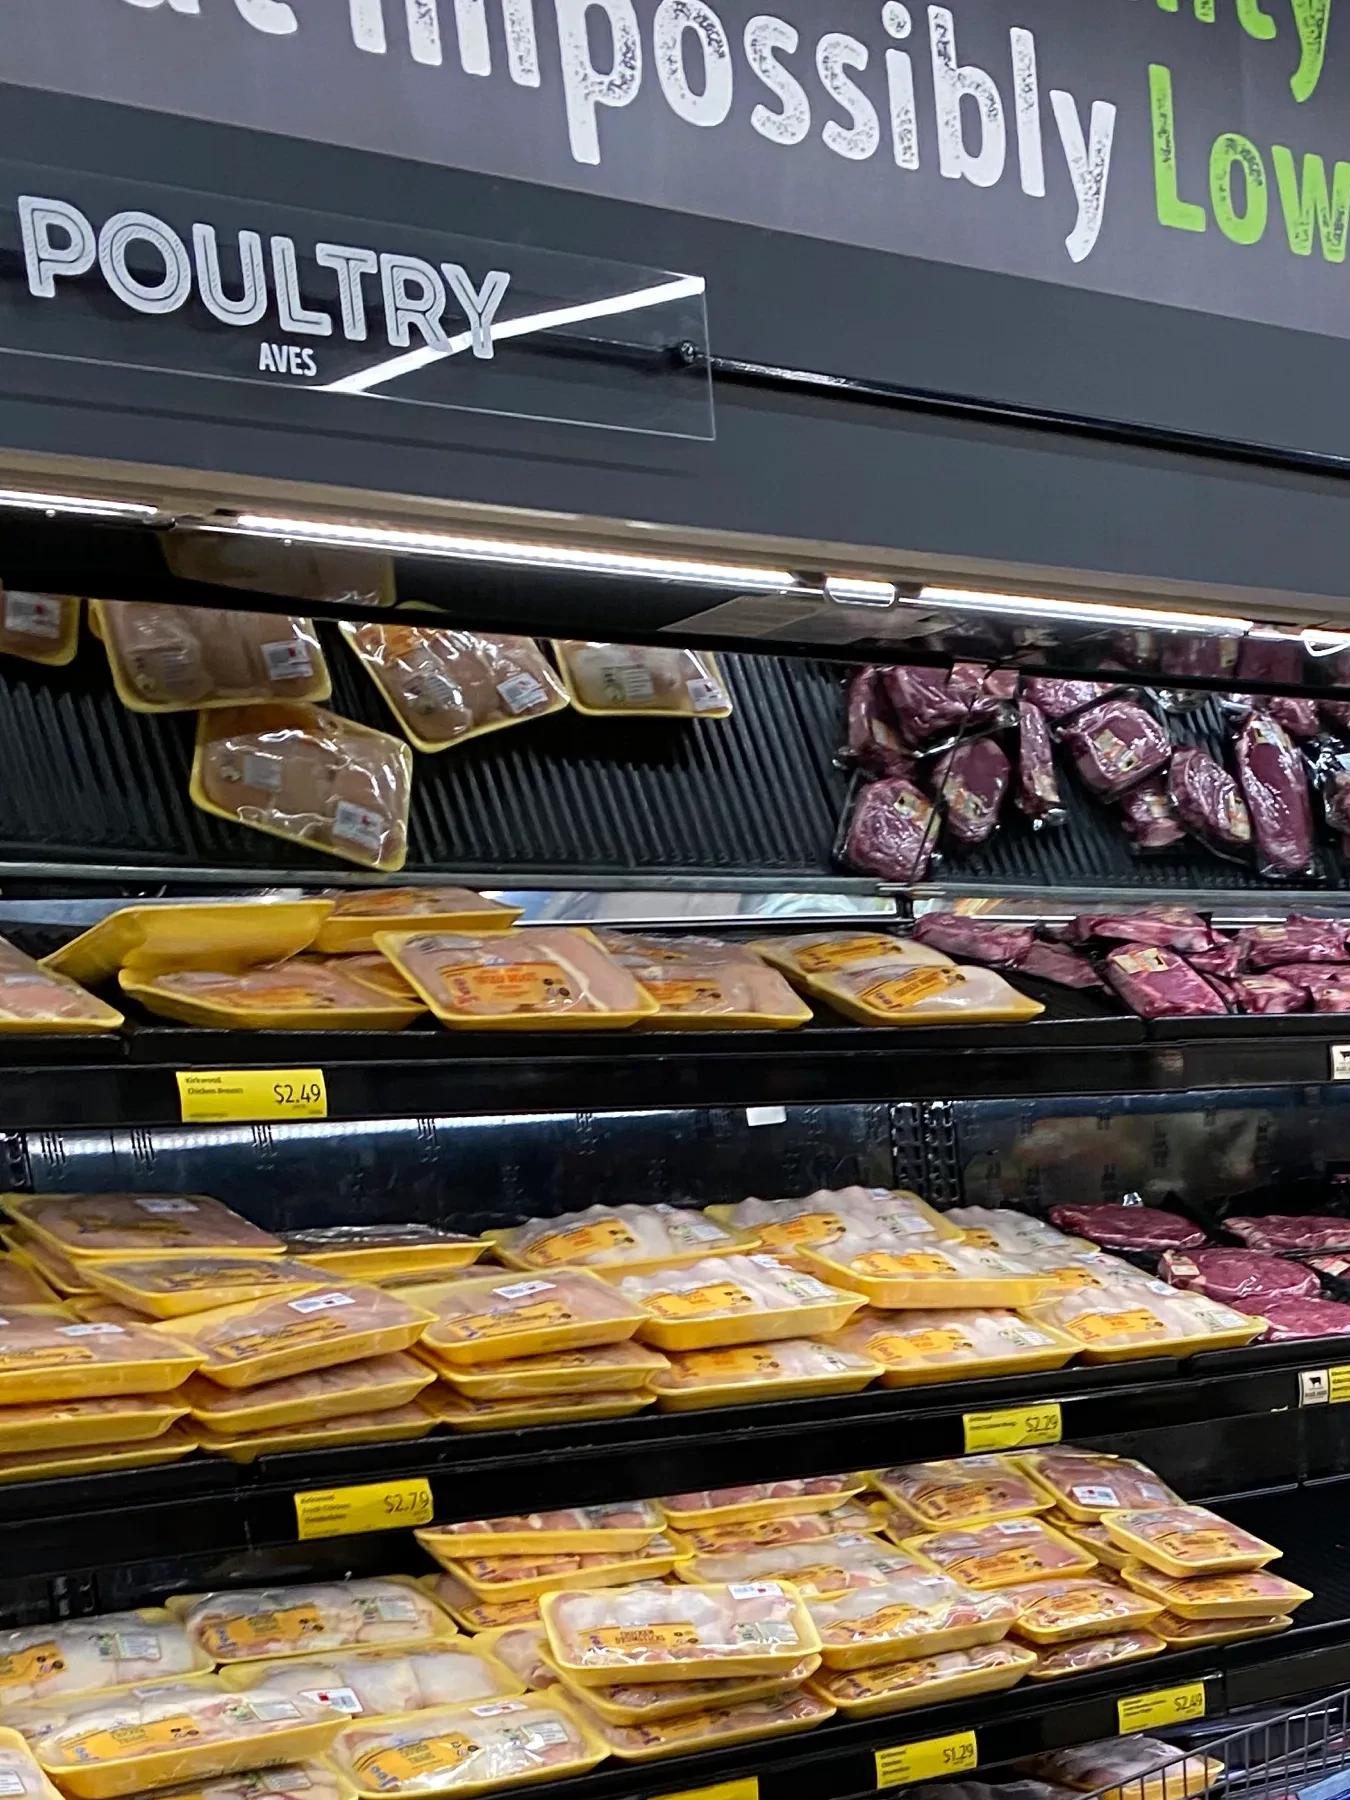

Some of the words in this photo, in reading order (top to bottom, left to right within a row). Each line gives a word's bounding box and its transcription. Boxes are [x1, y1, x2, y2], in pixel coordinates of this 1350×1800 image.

[18, 195, 511, 360] POULTRY
[259, 342, 317, 376] AVES
[274, 1083, 321, 1105] $2.49
[384, 1491, 430, 1513] $2.79
